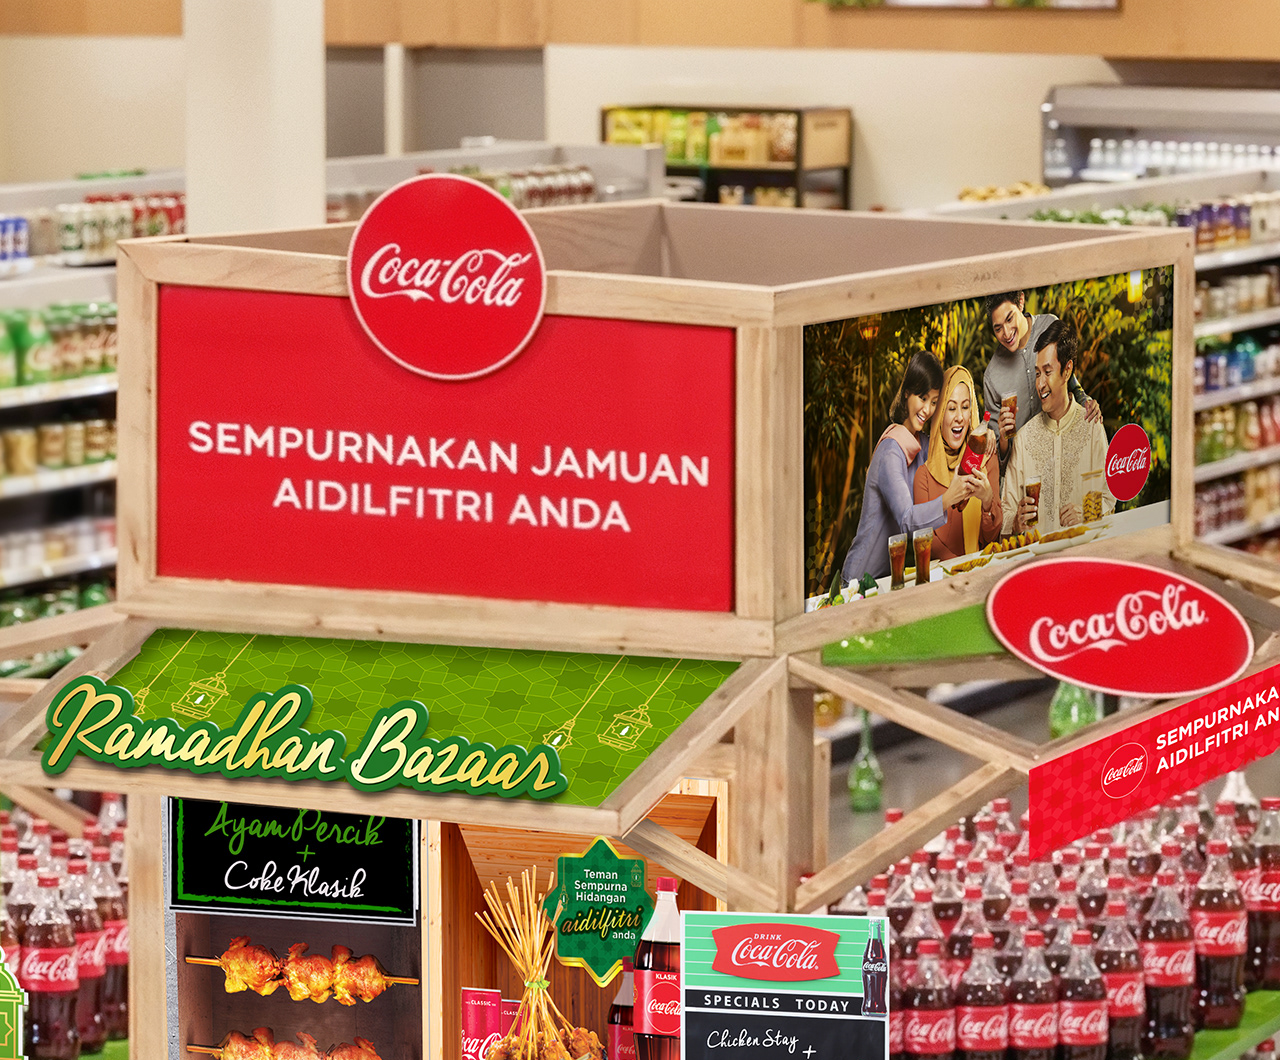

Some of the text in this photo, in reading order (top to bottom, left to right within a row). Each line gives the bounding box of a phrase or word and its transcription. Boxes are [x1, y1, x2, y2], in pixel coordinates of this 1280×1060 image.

[361, 243, 531, 306] Coca-Cola
[188, 421, 710, 487] SEMPURNAKAN JAMUAN
[273, 479, 631, 533] AIDILFITRI ANDA
[1028, 584, 1206, 663] Coca-Cola
[48, 683, 556, 791] Ramadhan Bazaar
[1156, 720, 1251, 774] AIDILFITRI
[204, 801, 386, 855] Ayam Percik
[224, 860, 367, 899] Coke Klasik
[574, 880, 628, 894] Sempurna
[583, 869, 618, 880] Teman
[575, 891, 626, 904] Hidangan
[562, 907, 642, 938] aidilfitri
[612, 930, 636, 940] anda
[754, 933, 782, 941] DRINK
[731, 937, 822, 970] Coca-Cola
[655, 973, 678, 981] KLASIK
[470, 999, 492, 1007] CLASSIC
[704, 994, 849, 1012] SPECIALS TODAY
[706, 1028, 799, 1054] Chicken Stay
